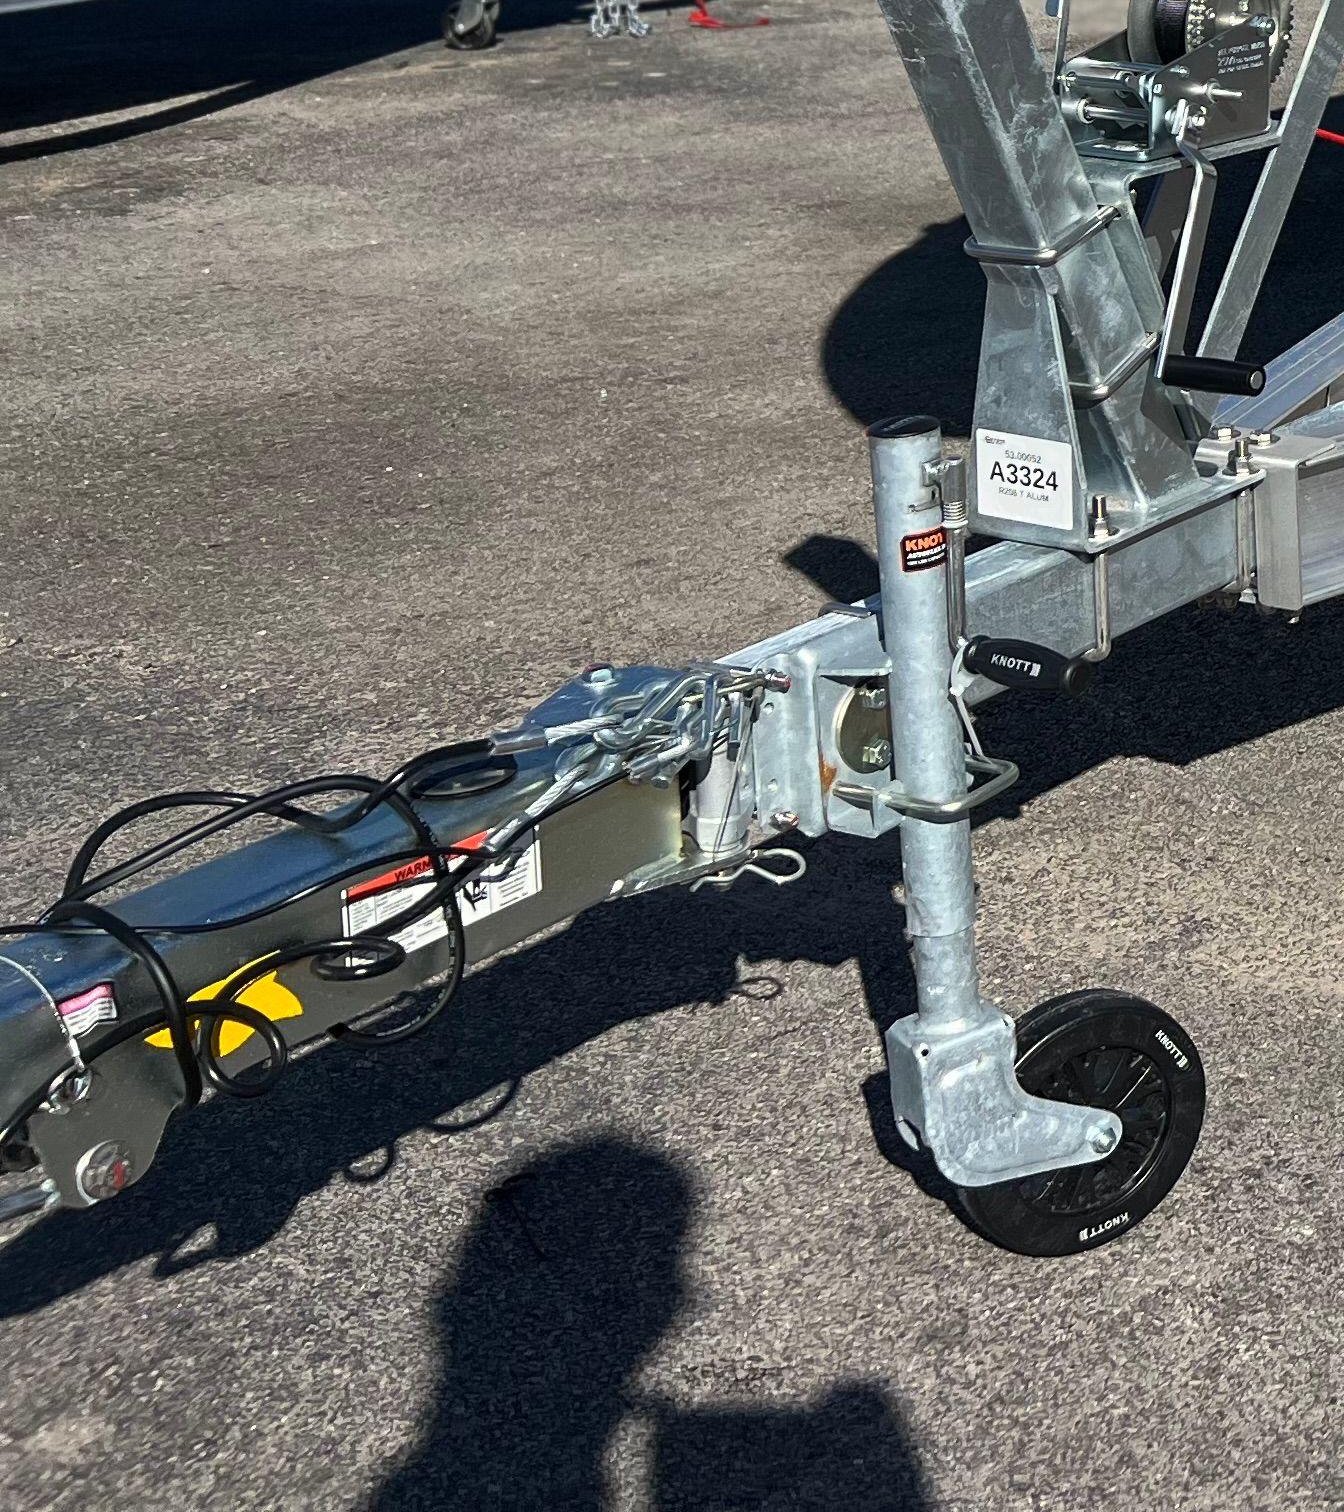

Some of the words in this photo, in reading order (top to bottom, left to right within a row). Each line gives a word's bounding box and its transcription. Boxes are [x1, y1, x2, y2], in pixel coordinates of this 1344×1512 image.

[989, 460, 1059, 492] A3324
[990, 653, 1031, 672] KNOTT
[1155, 1029, 1183, 1059] KNOTT
[1089, 1211, 1130, 1238] KNOTT
